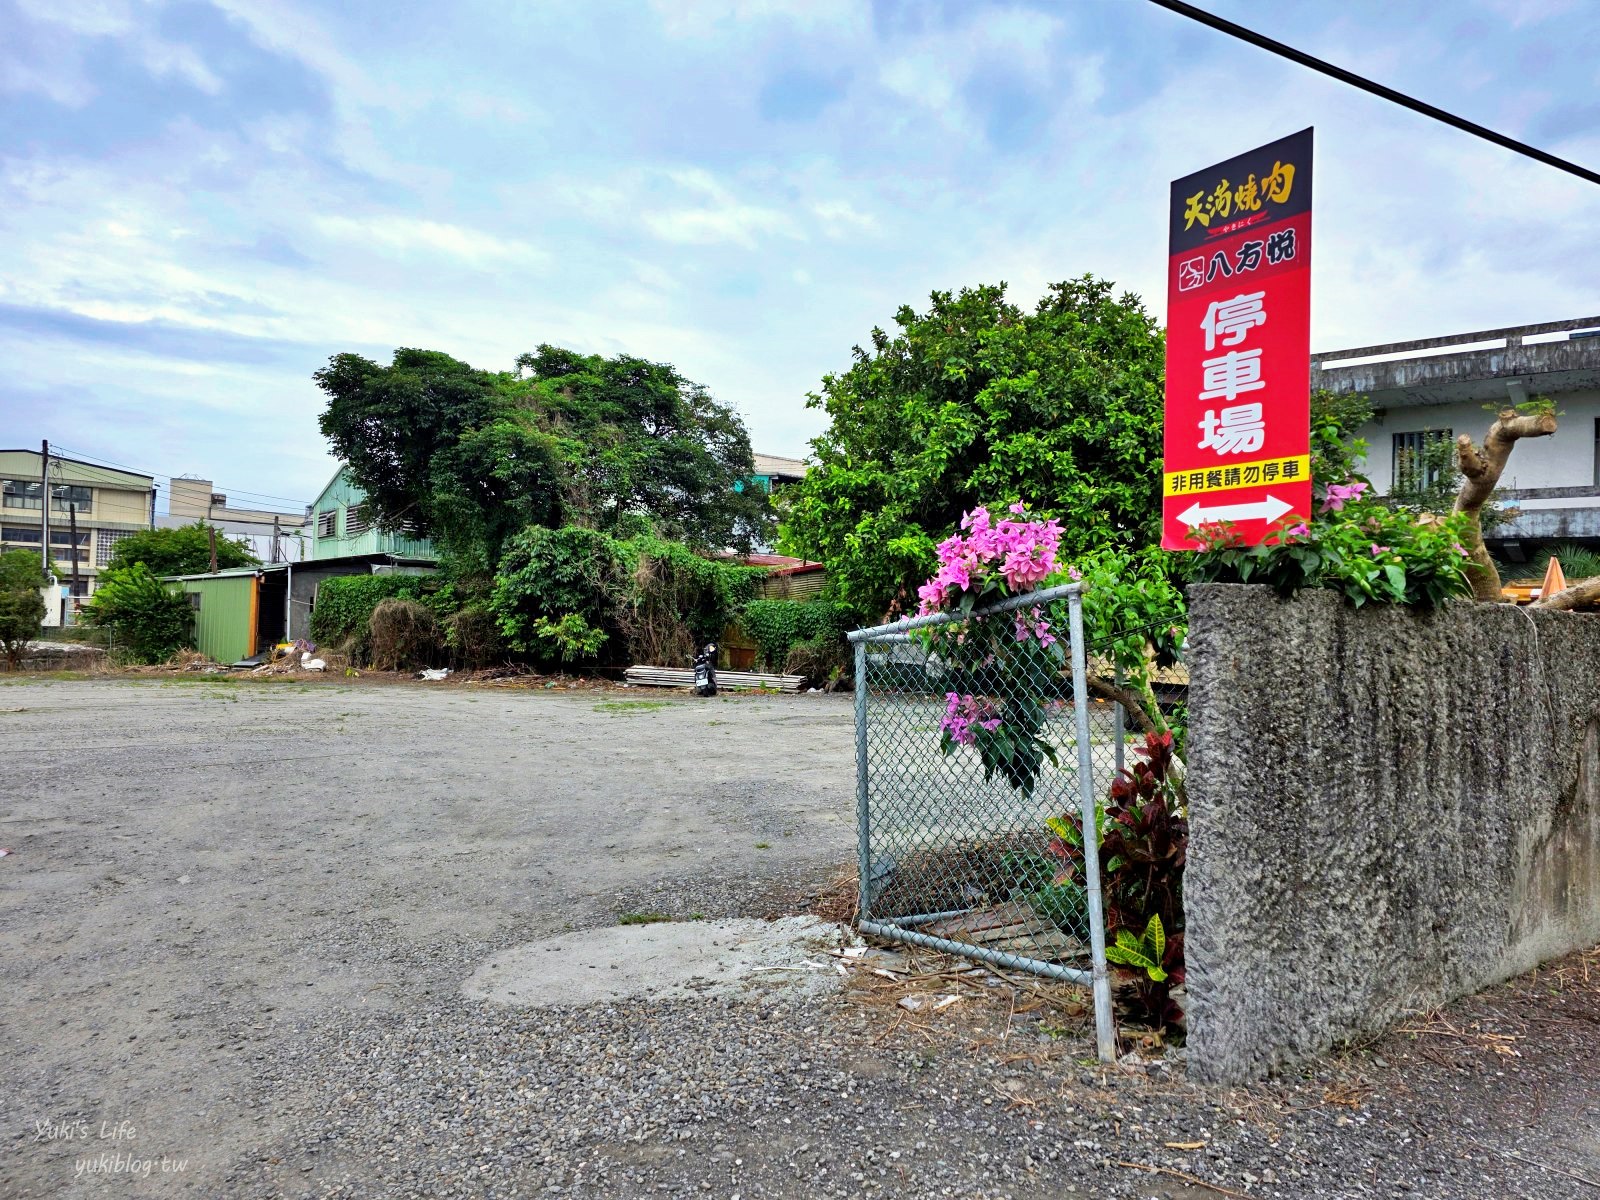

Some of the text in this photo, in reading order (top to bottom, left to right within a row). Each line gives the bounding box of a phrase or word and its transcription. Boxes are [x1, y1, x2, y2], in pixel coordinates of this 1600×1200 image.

[1198, 290, 1267, 456] 停車場
[1171, 460, 1300, 493] 非用餐請勿停車
